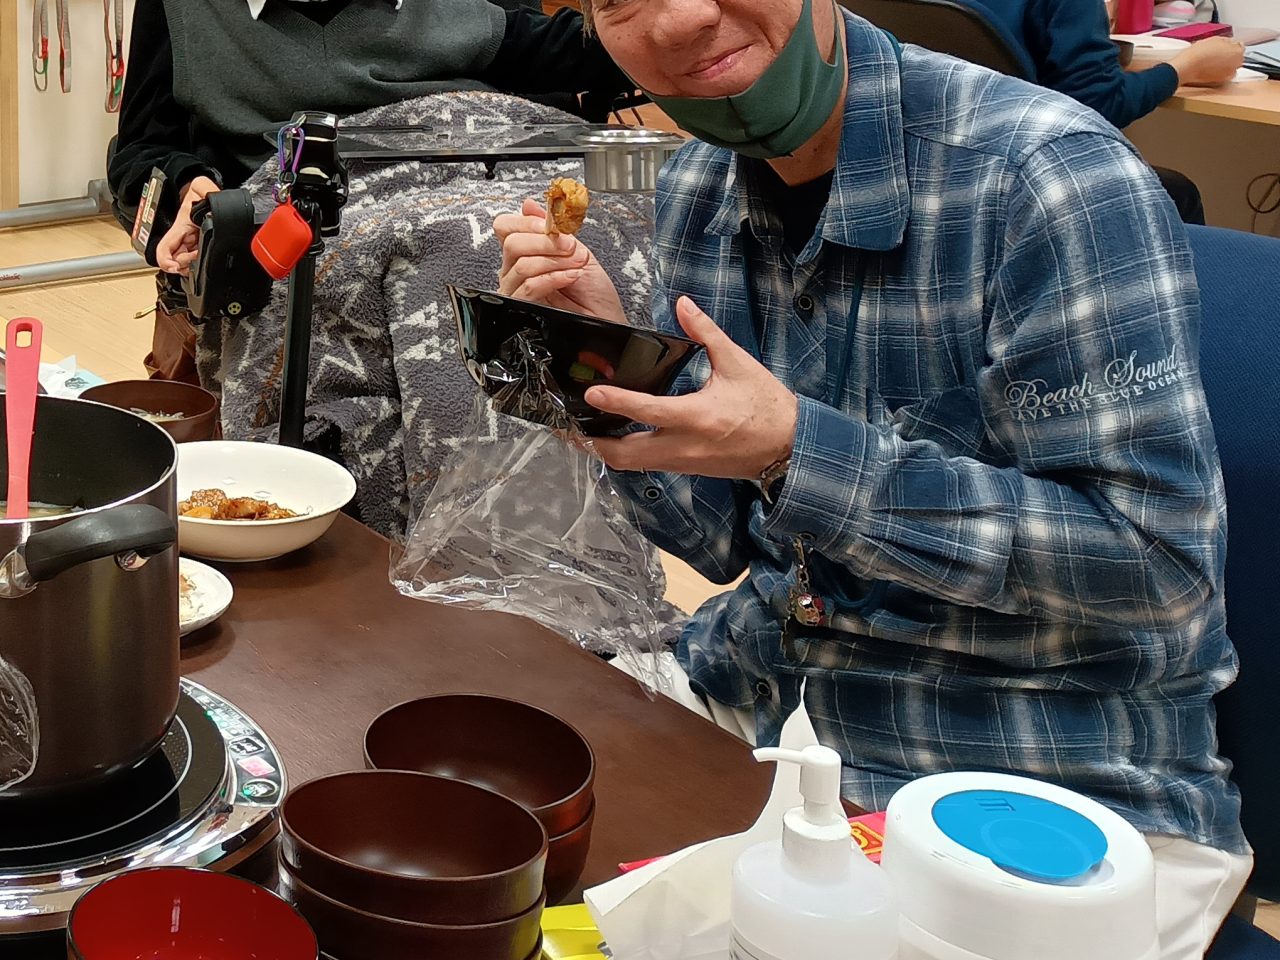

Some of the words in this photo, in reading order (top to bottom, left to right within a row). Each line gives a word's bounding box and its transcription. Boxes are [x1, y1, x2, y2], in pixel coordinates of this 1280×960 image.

[1004, 371, 1094, 411] Beach
[1104, 343, 1182, 389] Sound
[1056, 398, 1092, 416] THE
[1148, 367, 1185, 391] OCEAN
